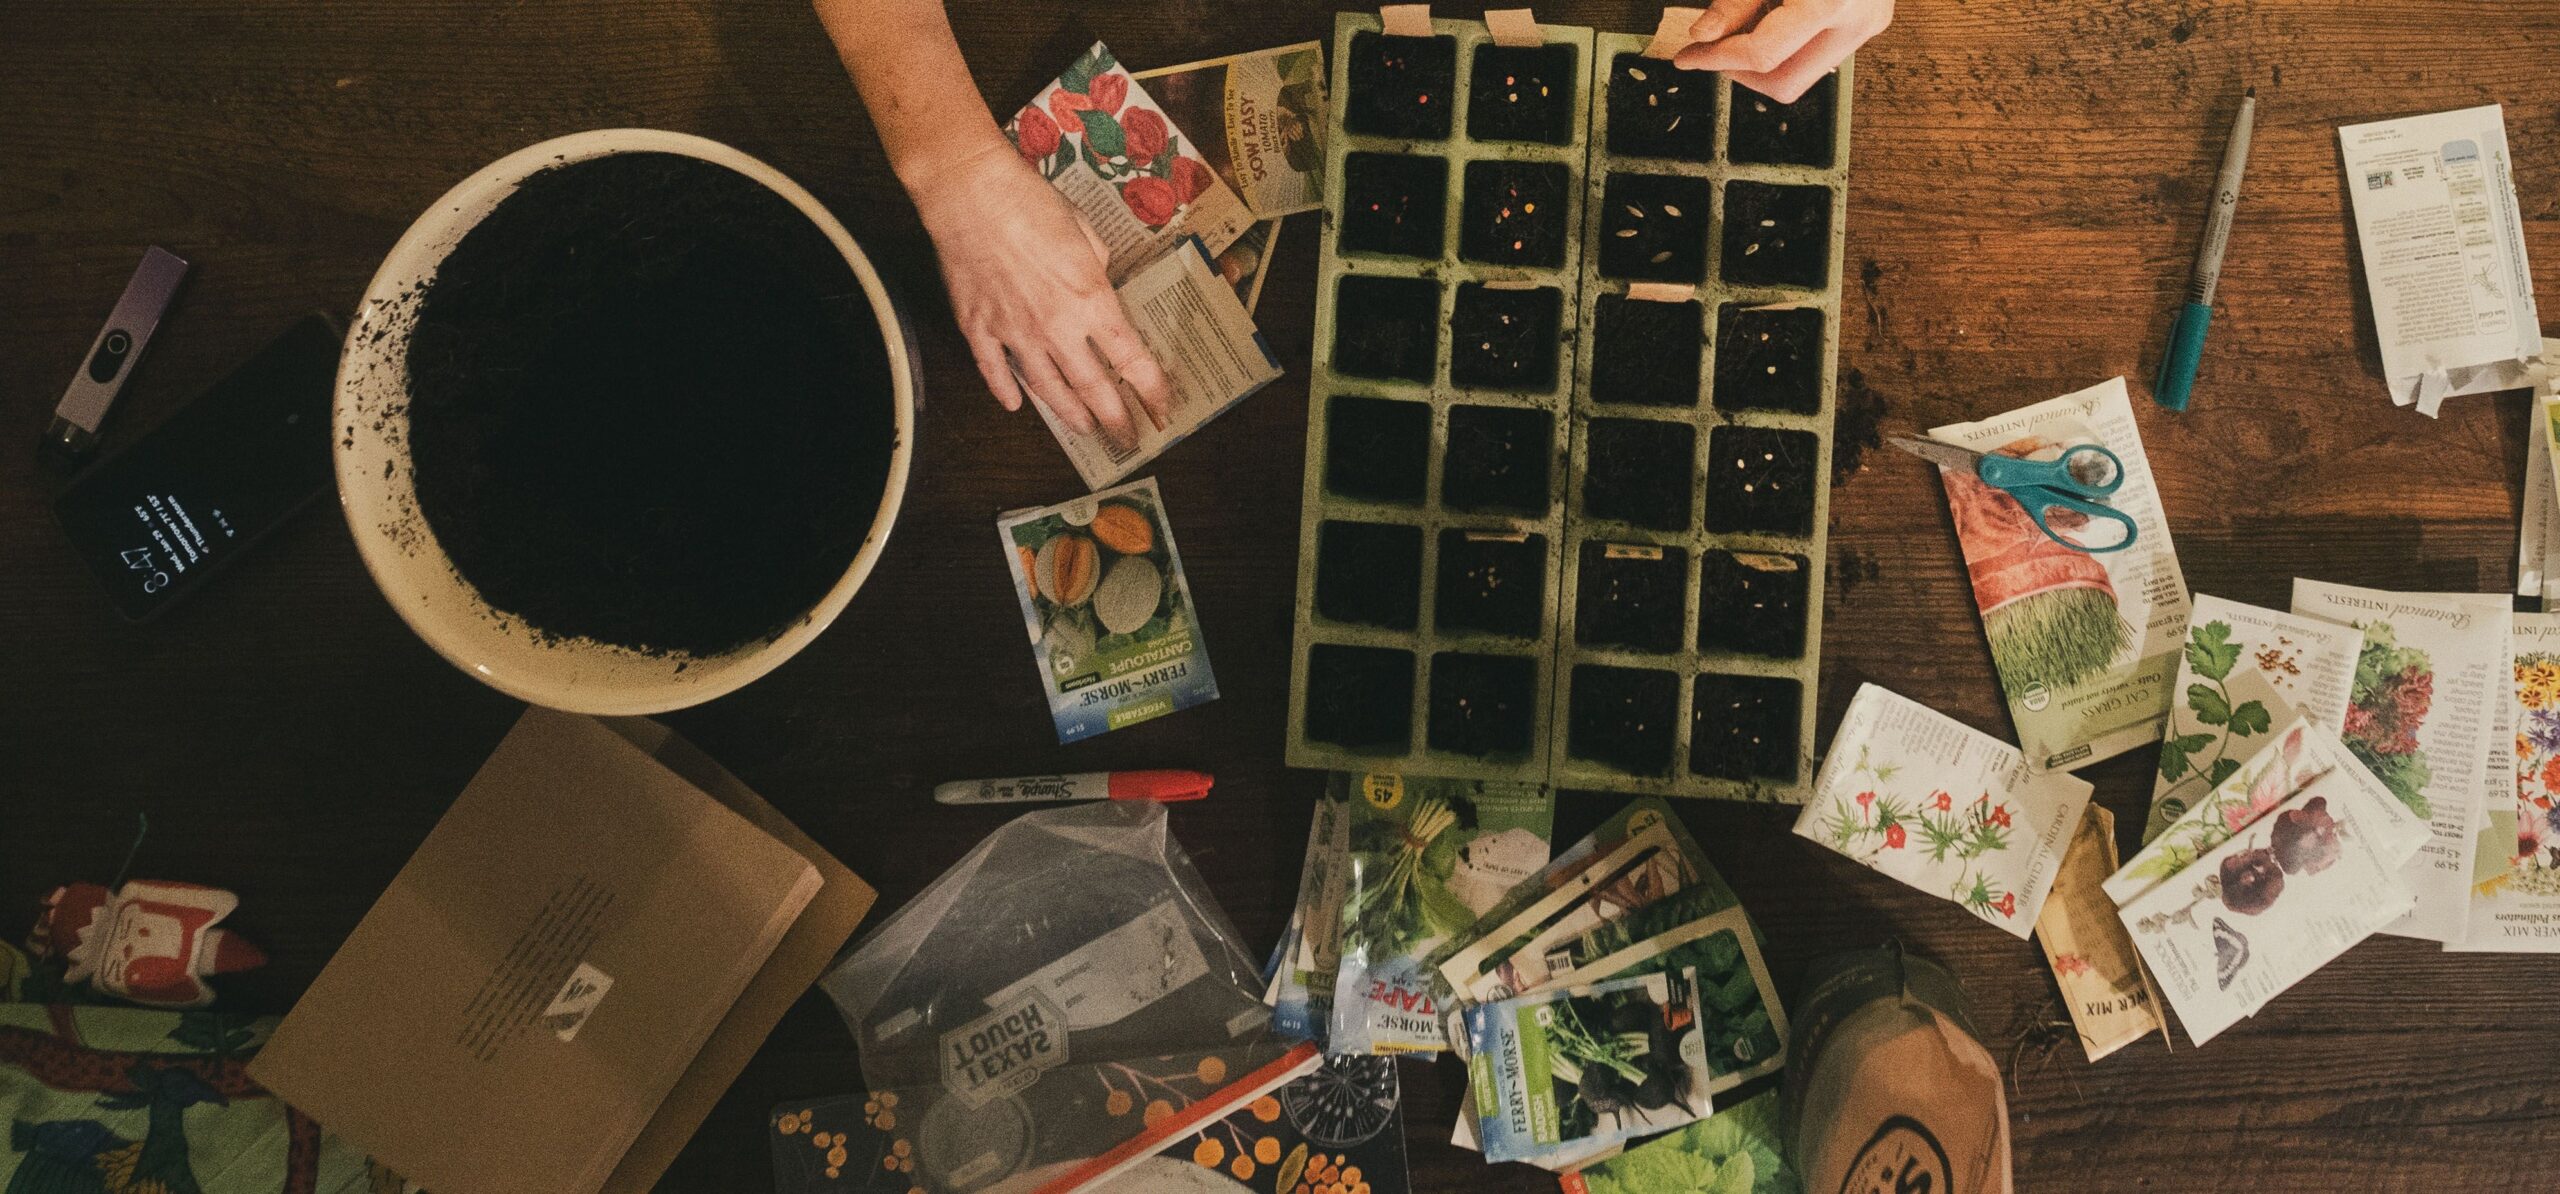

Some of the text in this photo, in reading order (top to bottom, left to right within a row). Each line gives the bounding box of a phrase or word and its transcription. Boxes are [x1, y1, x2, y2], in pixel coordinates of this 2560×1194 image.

[1240, 97, 1256, 136] EASY
[1259, 114, 1271, 152] TOMATO
[1246, 142, 1266, 181] SOW
[2024, 397, 2102, 431] Botanical
[151, 528, 163, 541] 29
[166, 493, 206, 547] Thunderstorm
[158, 537, 173, 554] Jan
[167, 520, 199, 563] Tomorrow
[119, 538, 171, 596] 8:47
[2386, 603, 2471, 631] Botanical
[1107, 639, 1193, 675] CANTALOUPE
[1111, 701, 1166, 723] VEGETABLE
[2080, 688, 2150, 720] CAT GRASS
[1373, 787, 1392, 803] 45
[2036, 801, 2071, 859] CARDINAL
[2014, 859, 2045, 908] CLIMBER
[2494, 911, 2549, 924] Pollinators
[2503, 925, 2528, 937] MIX
[2151, 940, 2193, 1001] HOLLYHOCK
[1366, 980, 1436, 1013] TAPE
[2085, 1000, 2112, 1017] MIX
[1380, 1014, 1433, 1034] MORSE
